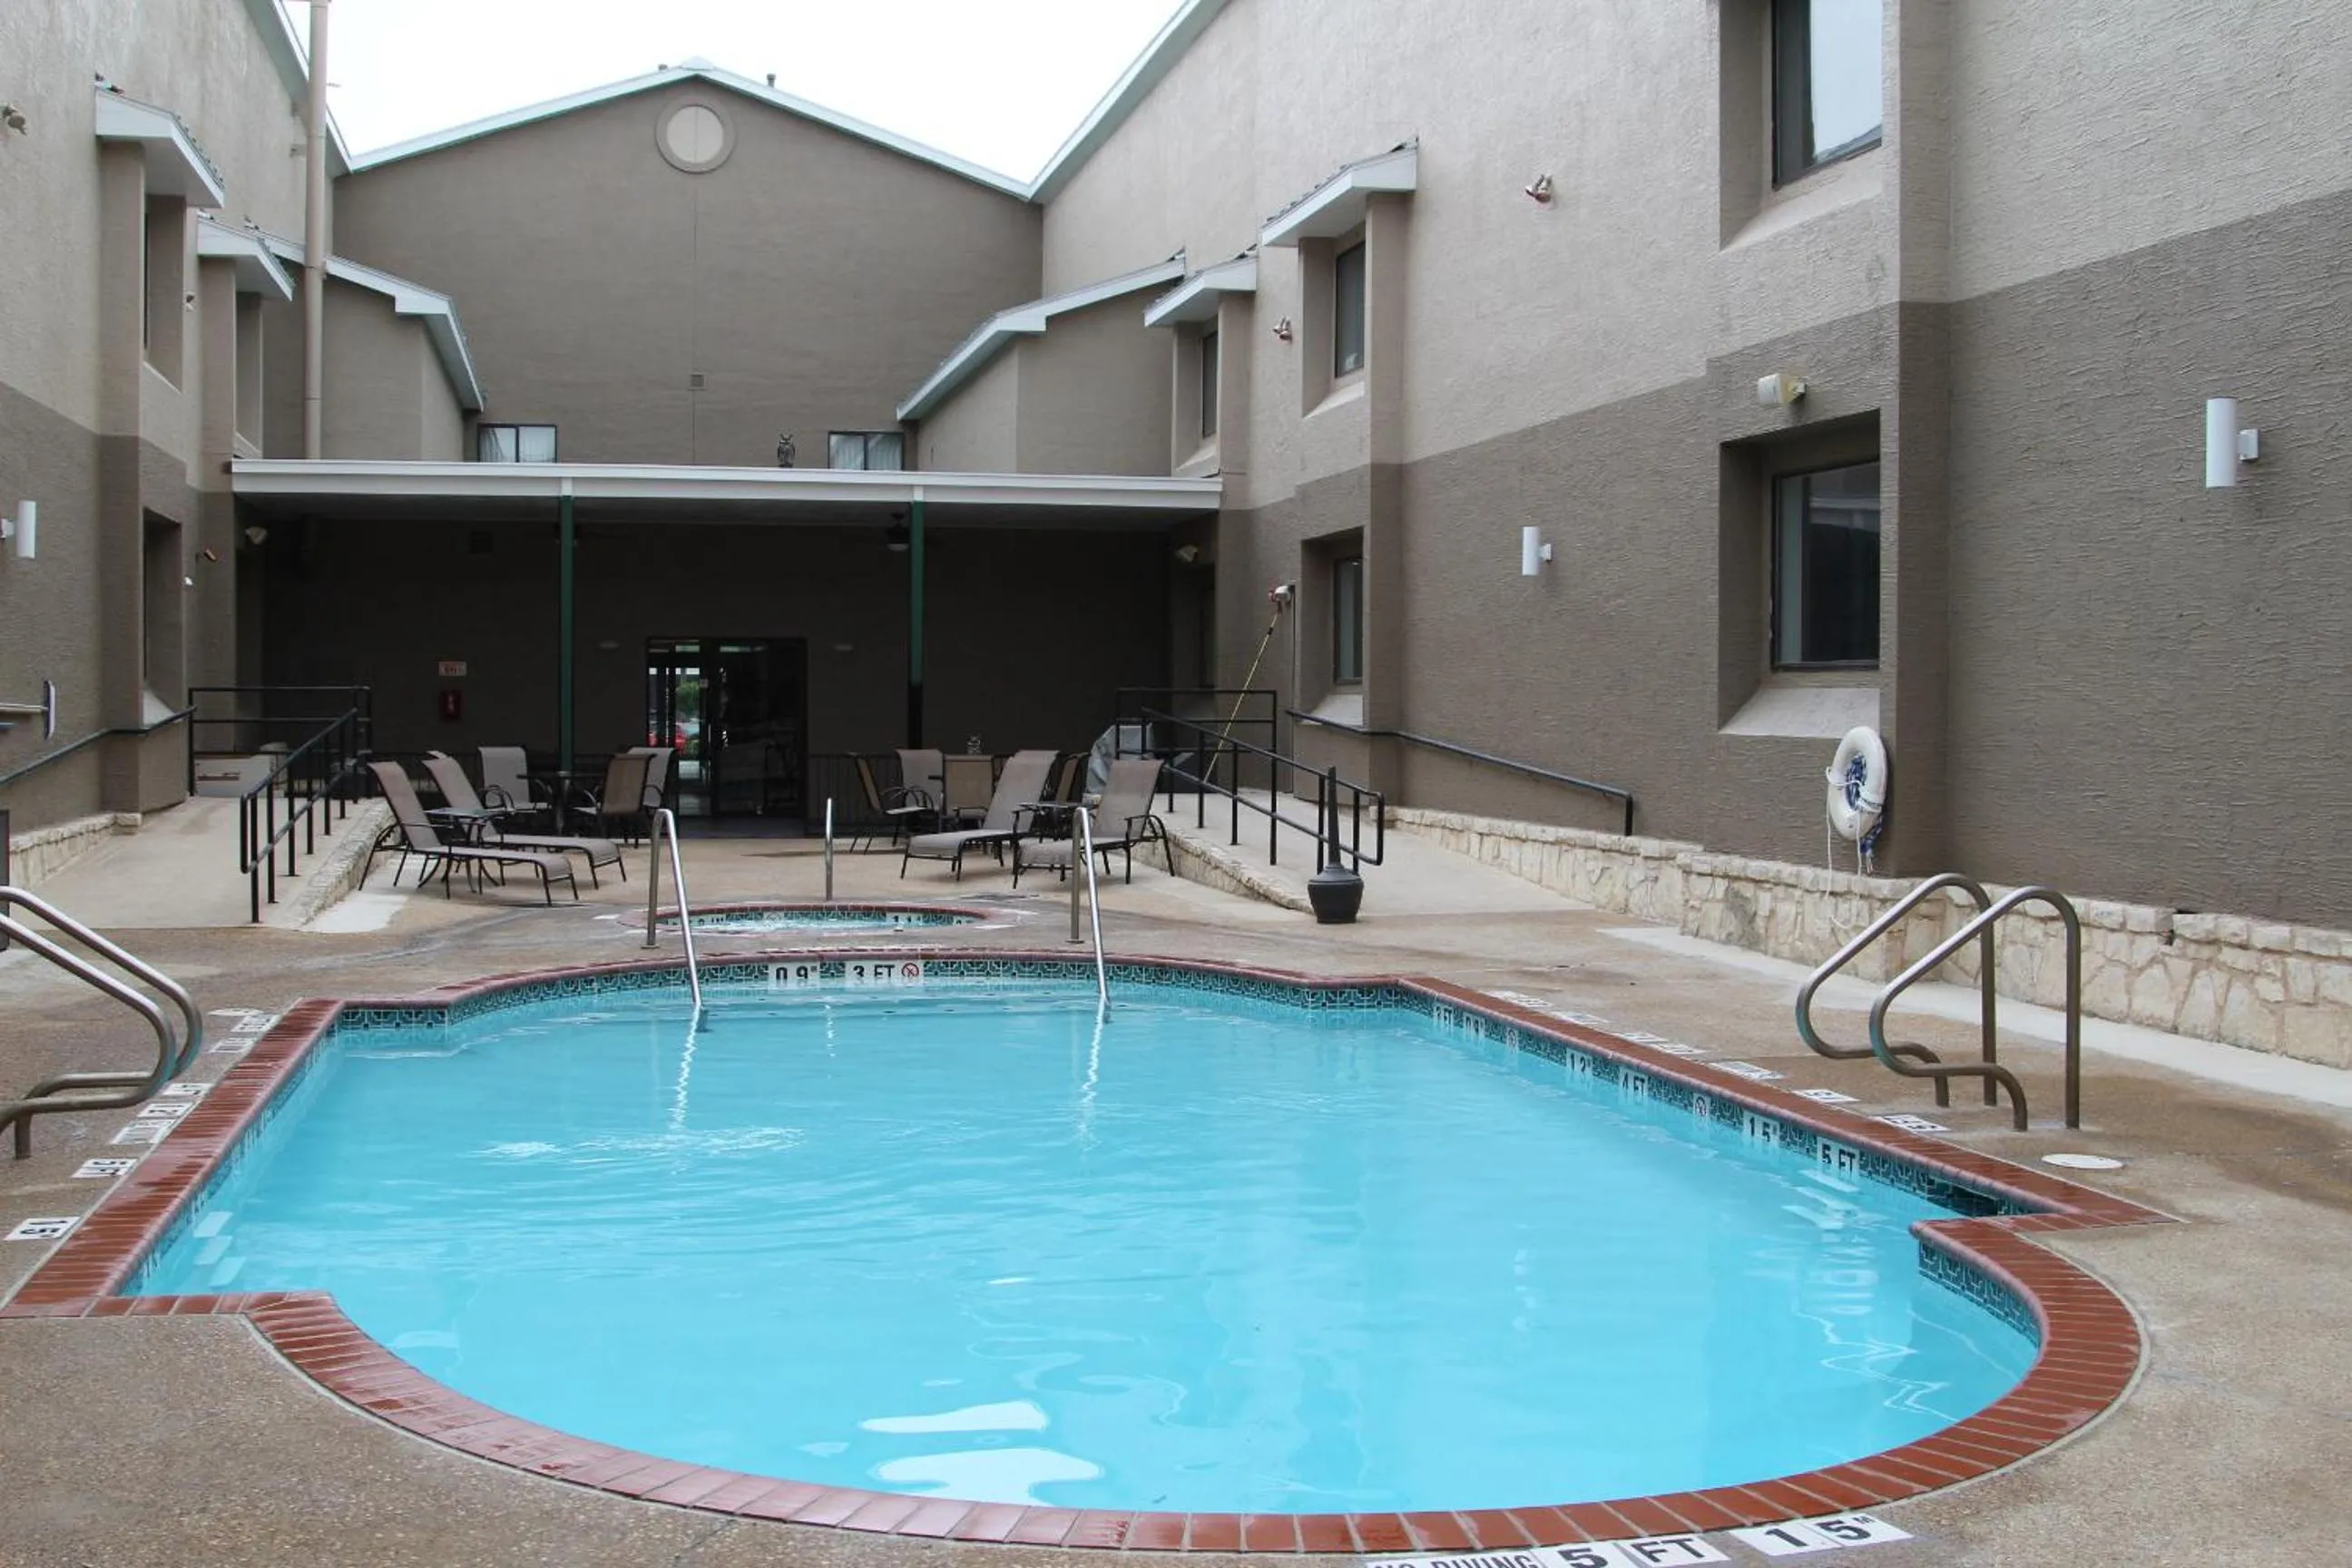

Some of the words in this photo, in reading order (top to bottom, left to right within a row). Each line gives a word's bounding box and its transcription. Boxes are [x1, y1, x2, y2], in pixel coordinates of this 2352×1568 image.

[874, 965, 895, 977] FT
[1556, 1547, 1608, 1568] 5
[1631, 1538, 1705, 1563] FT
